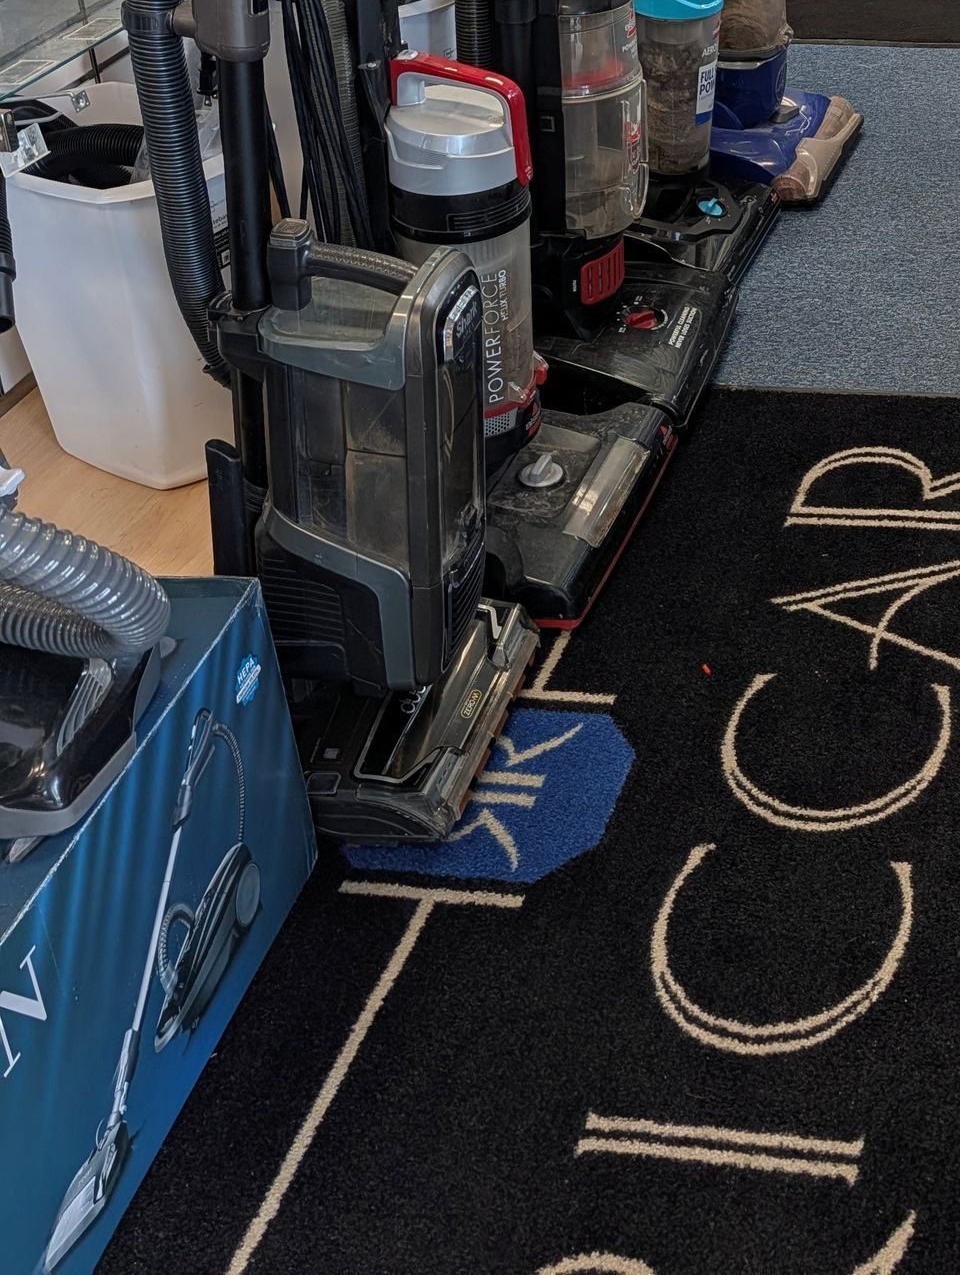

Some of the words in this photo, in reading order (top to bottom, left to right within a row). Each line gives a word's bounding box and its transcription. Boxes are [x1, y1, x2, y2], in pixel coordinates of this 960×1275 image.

[498, 268, 507, 299] TURBO
[481, 273, 505, 404] POWERFORCE
[235, 655, 257, 685] HEPA
